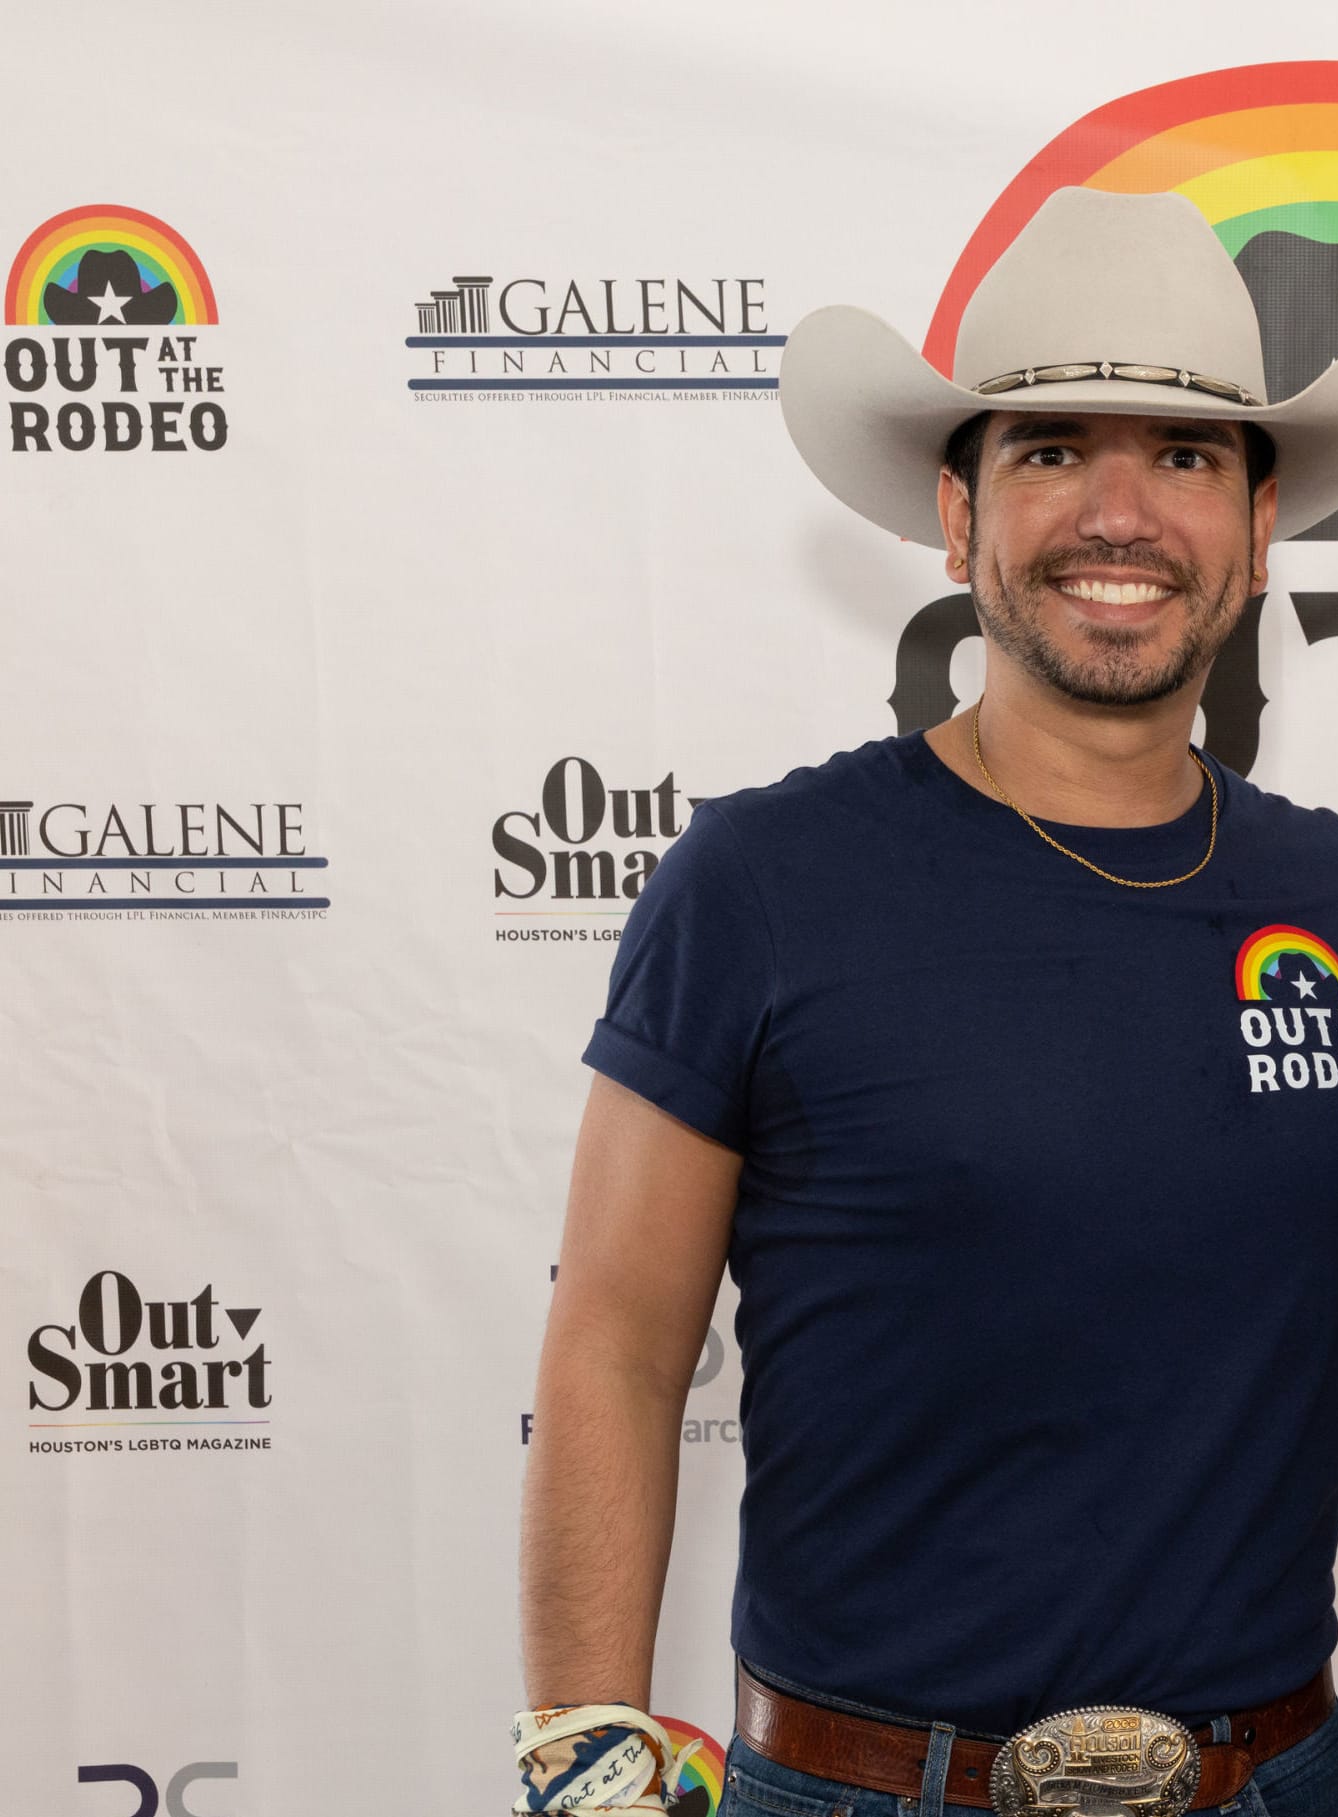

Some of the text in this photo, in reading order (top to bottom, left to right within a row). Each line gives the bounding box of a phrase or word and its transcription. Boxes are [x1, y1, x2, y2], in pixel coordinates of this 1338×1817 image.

[499, 279, 769, 335] GALENE
[4, 337, 198, 392] OUT AT
[158, 367, 225, 393] THE
[432, 350, 767, 374] FINANCIAL
[478, 392, 525, 402] OFFERED
[529, 392, 583, 402] THROUGH
[586, 391, 606, 401] LPL
[673, 391, 719, 401] MEMBER
[9, 402, 229, 452] RODEO
[542, 756, 683, 844] Out
[39, 803, 306, 857] GALENE
[492, 811, 659, 900] Sma
[9, 871, 304, 893] INANCIAL
[17, 912, 64, 921] OFFERED
[68, 912, 122, 921] THROUGH
[127, 911, 145, 921] LPL
[212, 911, 258, 920] MEMBER
[261, 910, 327, 920] FINRA/SIPC
[593, 929, 622, 941] LGB
[1240, 1007, 1333, 1047] OUT
[79, 1270, 220, 1356] Out
[27, 1324, 272, 1412] Smart
[129, 1439, 182, 1451] LGBTQ
[187, 1437, 272, 1450] MAGAZINE
